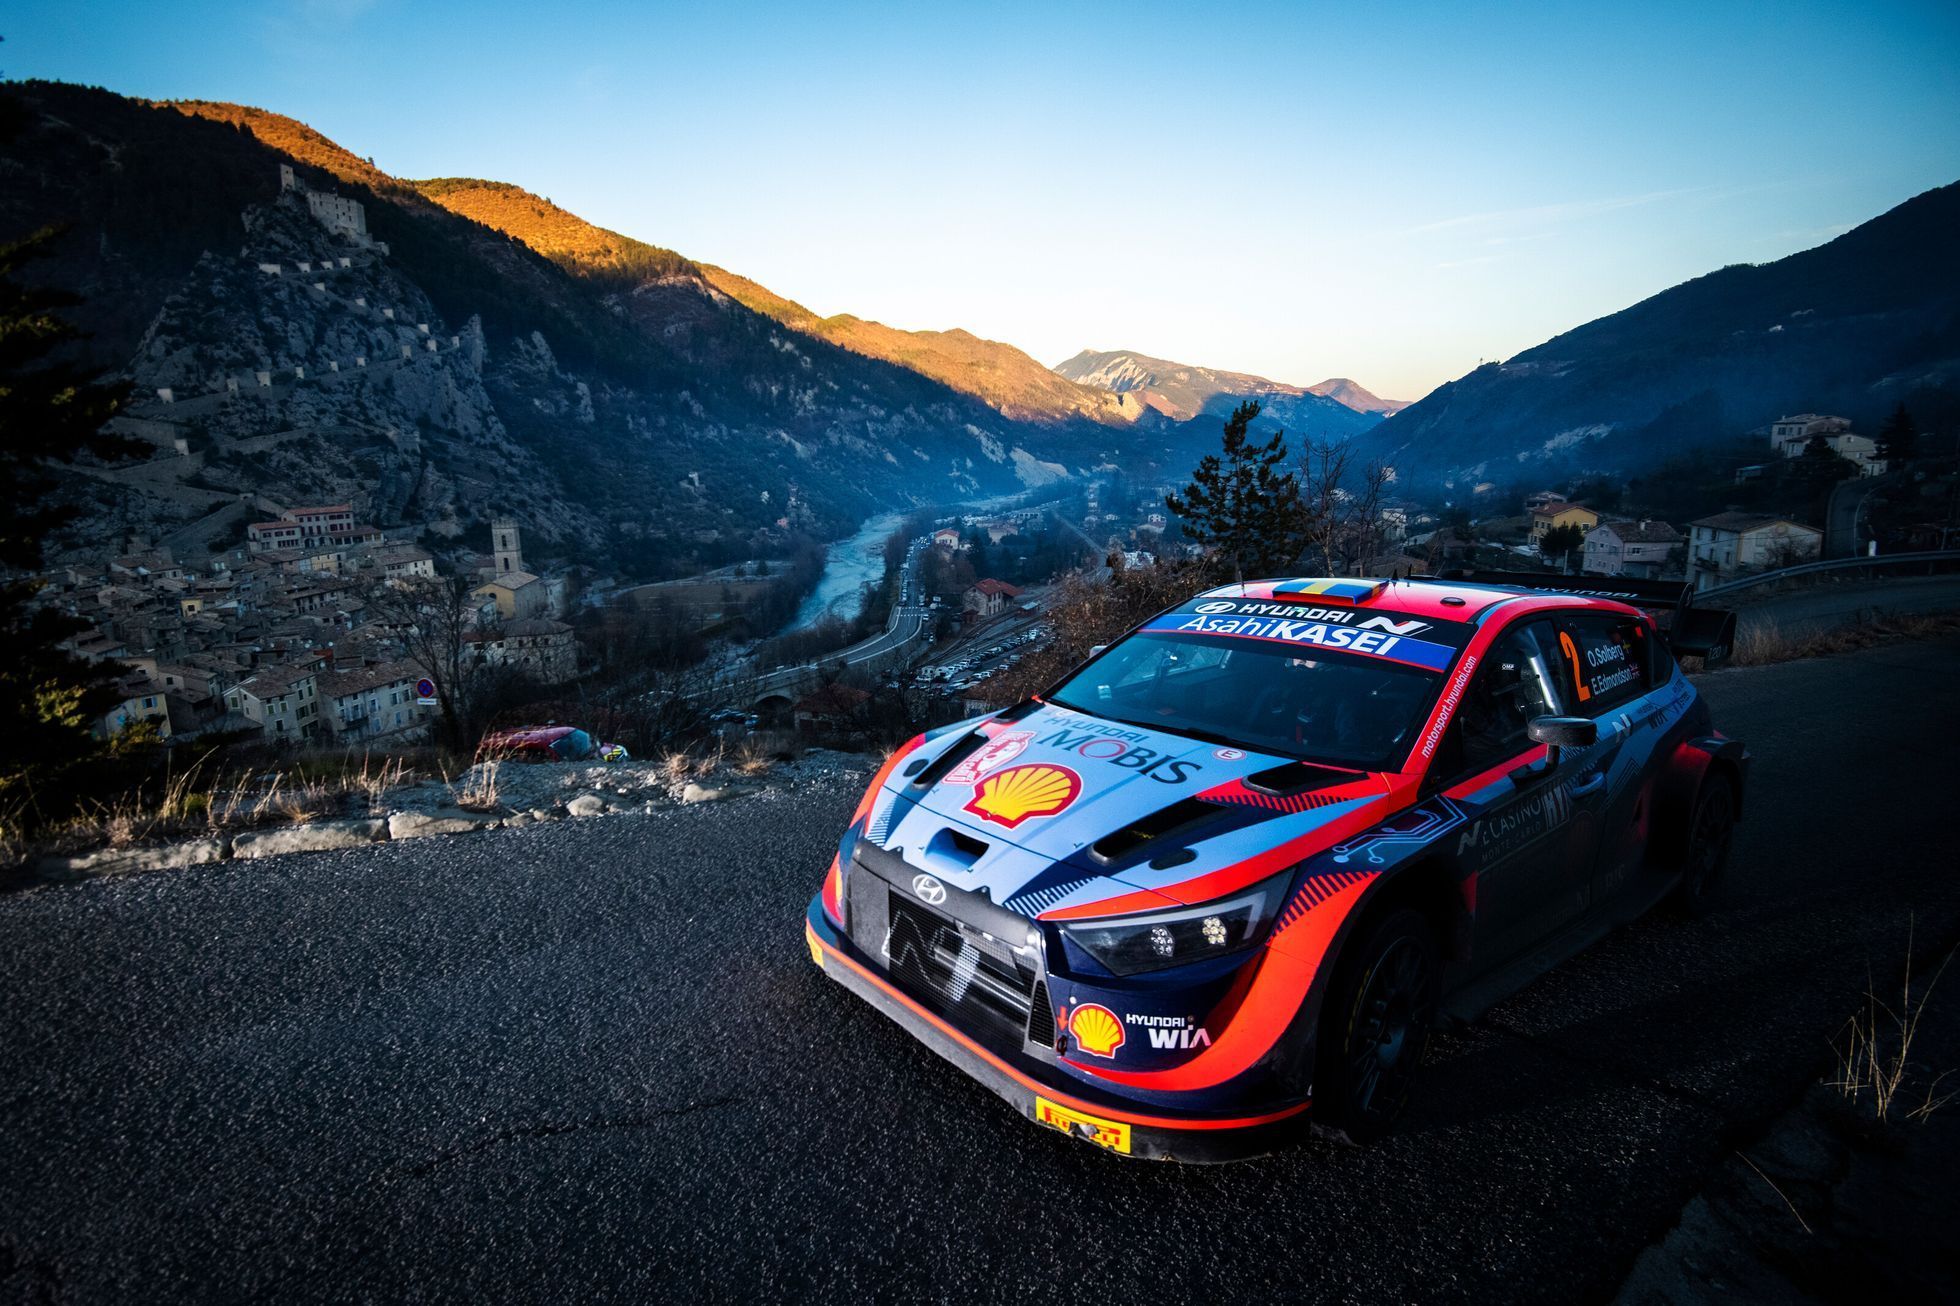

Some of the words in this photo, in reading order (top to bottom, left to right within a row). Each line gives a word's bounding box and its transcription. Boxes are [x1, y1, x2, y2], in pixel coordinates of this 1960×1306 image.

[1237, 602, 1355, 624] HYUNDAI
[1559, 631, 1592, 703] 2
[1587, 644, 1625, 668] O.Solberg
[1590, 668, 1633, 696] E.Edmondson
[1420, 655, 1477, 760] motorsport.hyundai.com
[1045, 715, 1150, 744] HYUNDAI
[1036, 729, 1203, 785] MOBIS
[1126, 1013, 1185, 1028] HYUNDAI
